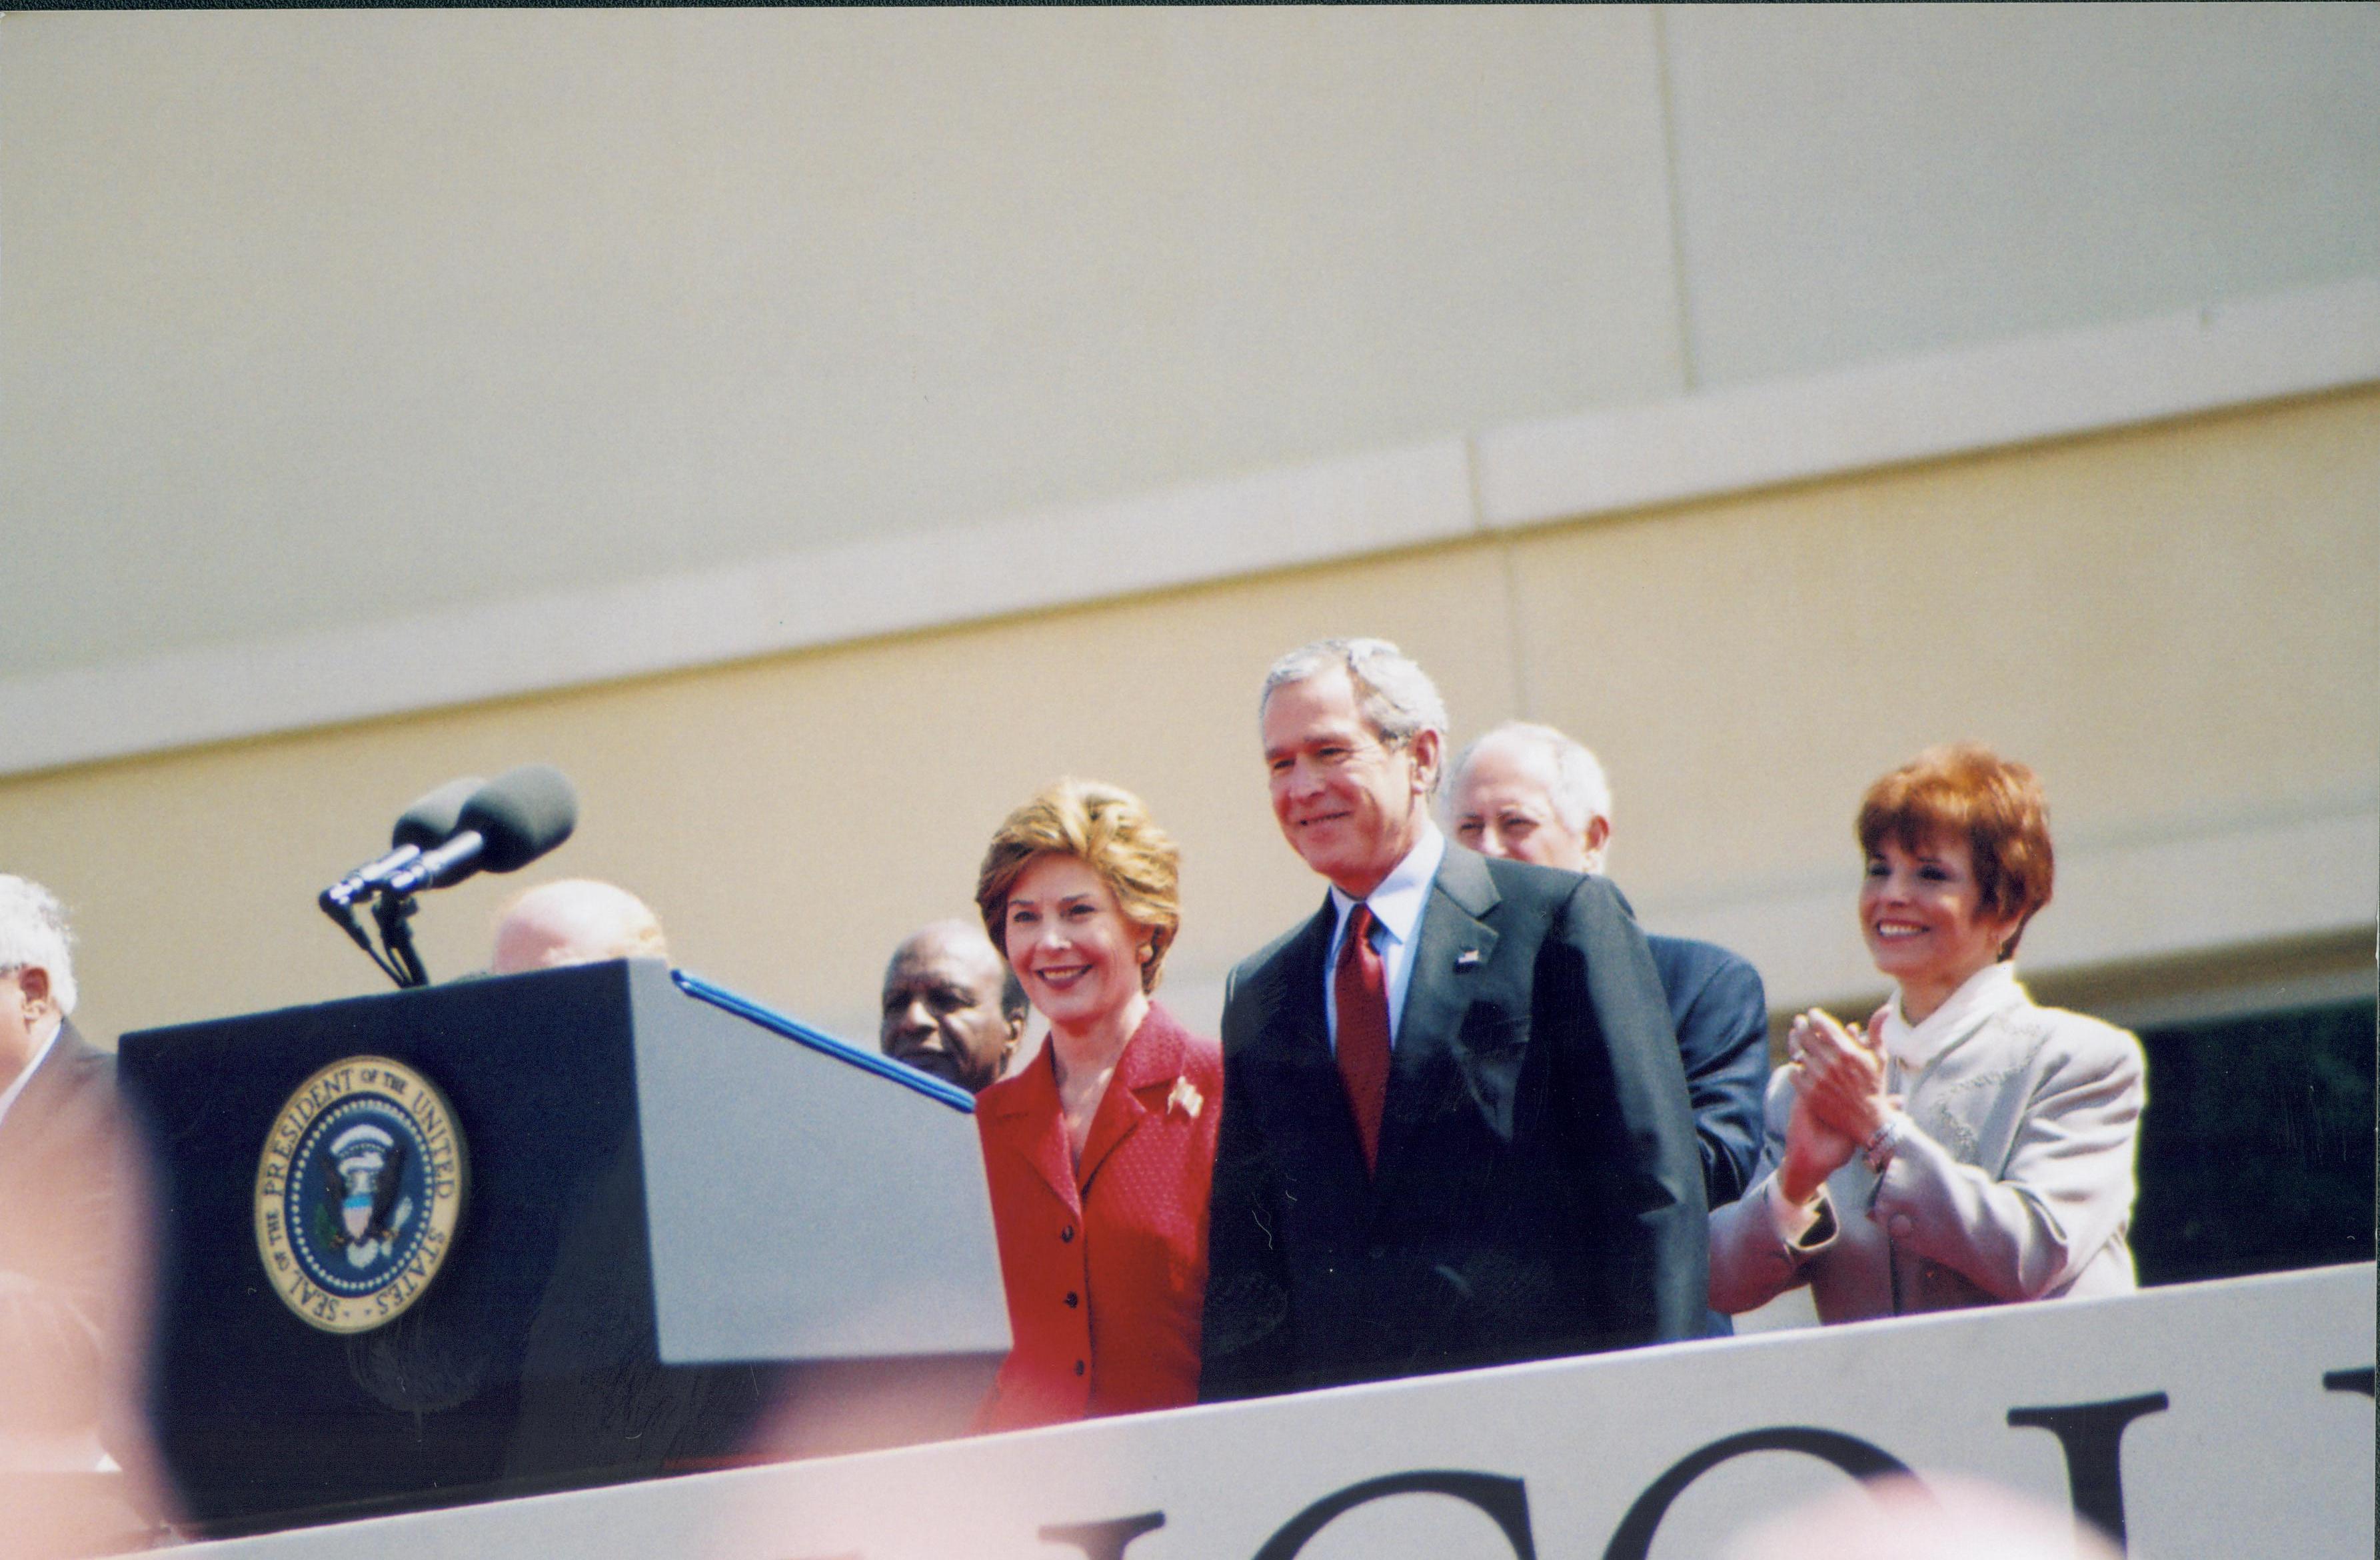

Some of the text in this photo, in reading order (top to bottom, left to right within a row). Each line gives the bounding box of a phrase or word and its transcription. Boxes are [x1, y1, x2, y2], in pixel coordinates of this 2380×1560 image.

[265, 1068, 454, 1321] SEAL OF THE PRESIDENT OF THE UNITED STATES
